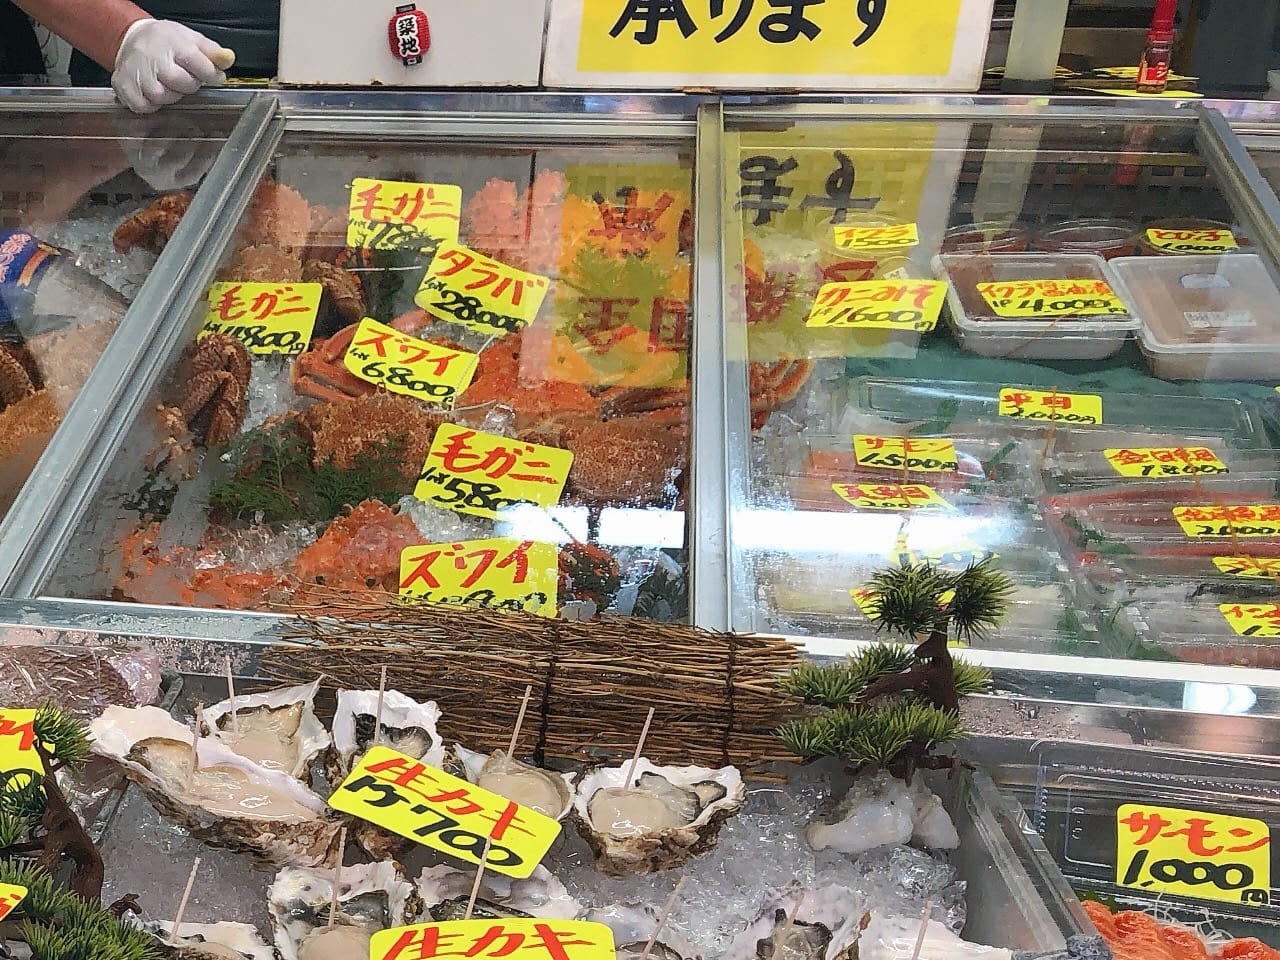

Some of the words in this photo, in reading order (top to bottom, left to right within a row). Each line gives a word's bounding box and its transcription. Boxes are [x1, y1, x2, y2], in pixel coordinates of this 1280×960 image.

[351, 184, 459, 224] 毛ガニ
[434, 250, 545, 306] タラバ
[210, 285, 310, 321] 毛ガニ
[354, 328, 460, 377] ズワイ
[431, 431, 559, 484] 毛ガニ
[400, 539, 535, 588] ズワイ
[364, 757, 536, 840] 生カキ
